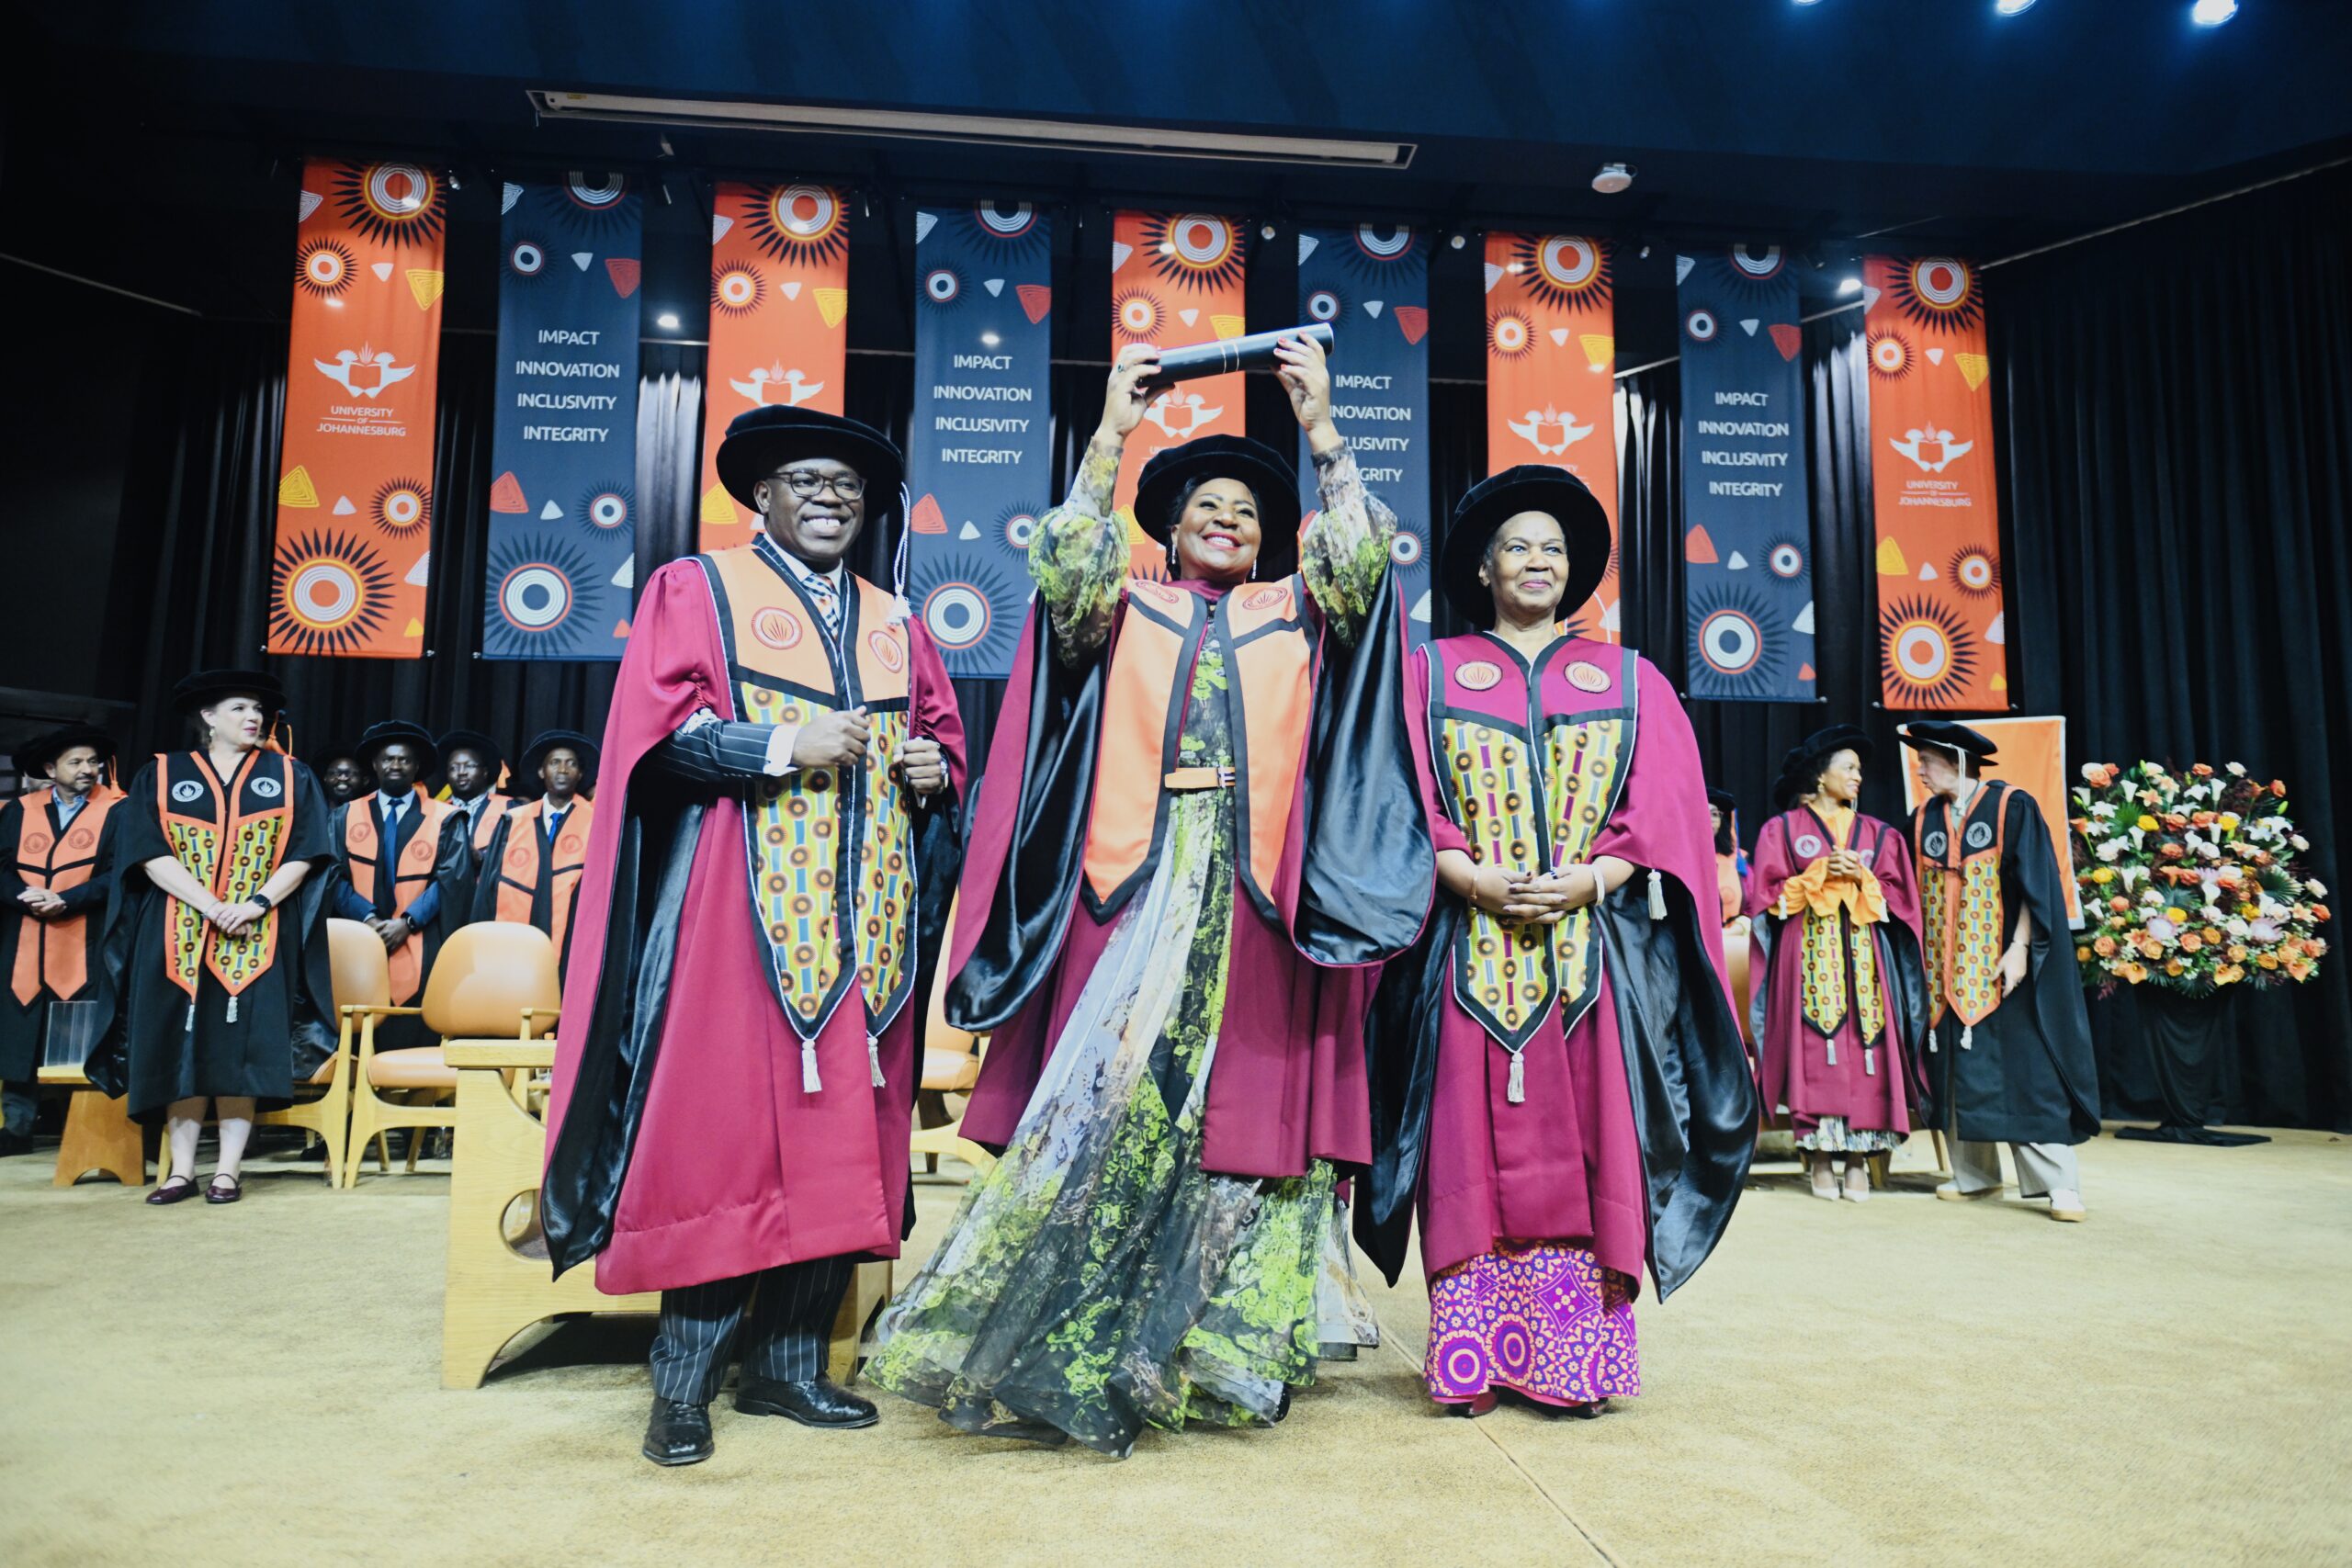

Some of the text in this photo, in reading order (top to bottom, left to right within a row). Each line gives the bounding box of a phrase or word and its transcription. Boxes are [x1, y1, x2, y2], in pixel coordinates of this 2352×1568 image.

[538, 330, 600, 345] IMPACT
[515, 360, 620, 378] INNOVATION
[954, 355, 1012, 370] IMPACT
[1335, 374, 1393, 389] IMPACT
[933, 385, 1033, 401] INNOVATION
[1714, 391, 1769, 407] IMPACT
[517, 392, 617, 411] INCLUSIVITY
[331, 405, 394, 418] UNIVERSITY
[1329, 404, 1412, 422] NOVATION
[316, 423, 406, 437] JOHANNESBURG
[935, 416, 1030, 433] INCLUSIVITY
[1698, 420, 1790, 437] INNOVATION
[523, 425, 609, 443] INTEGRITY
[1345, 435, 1410, 452] LUSIVITY
[942, 448, 1023, 465] INTEGRITY
[1702, 450, 1789, 468] INCLUSIVITY
[1359, 467, 1404, 482] GRITY
[1709, 480, 1783, 498] INTEGRITY
[1905, 480, 1959, 491] UNIVERSITY
[1898, 496, 1972, 508] JOHANNESBURG
